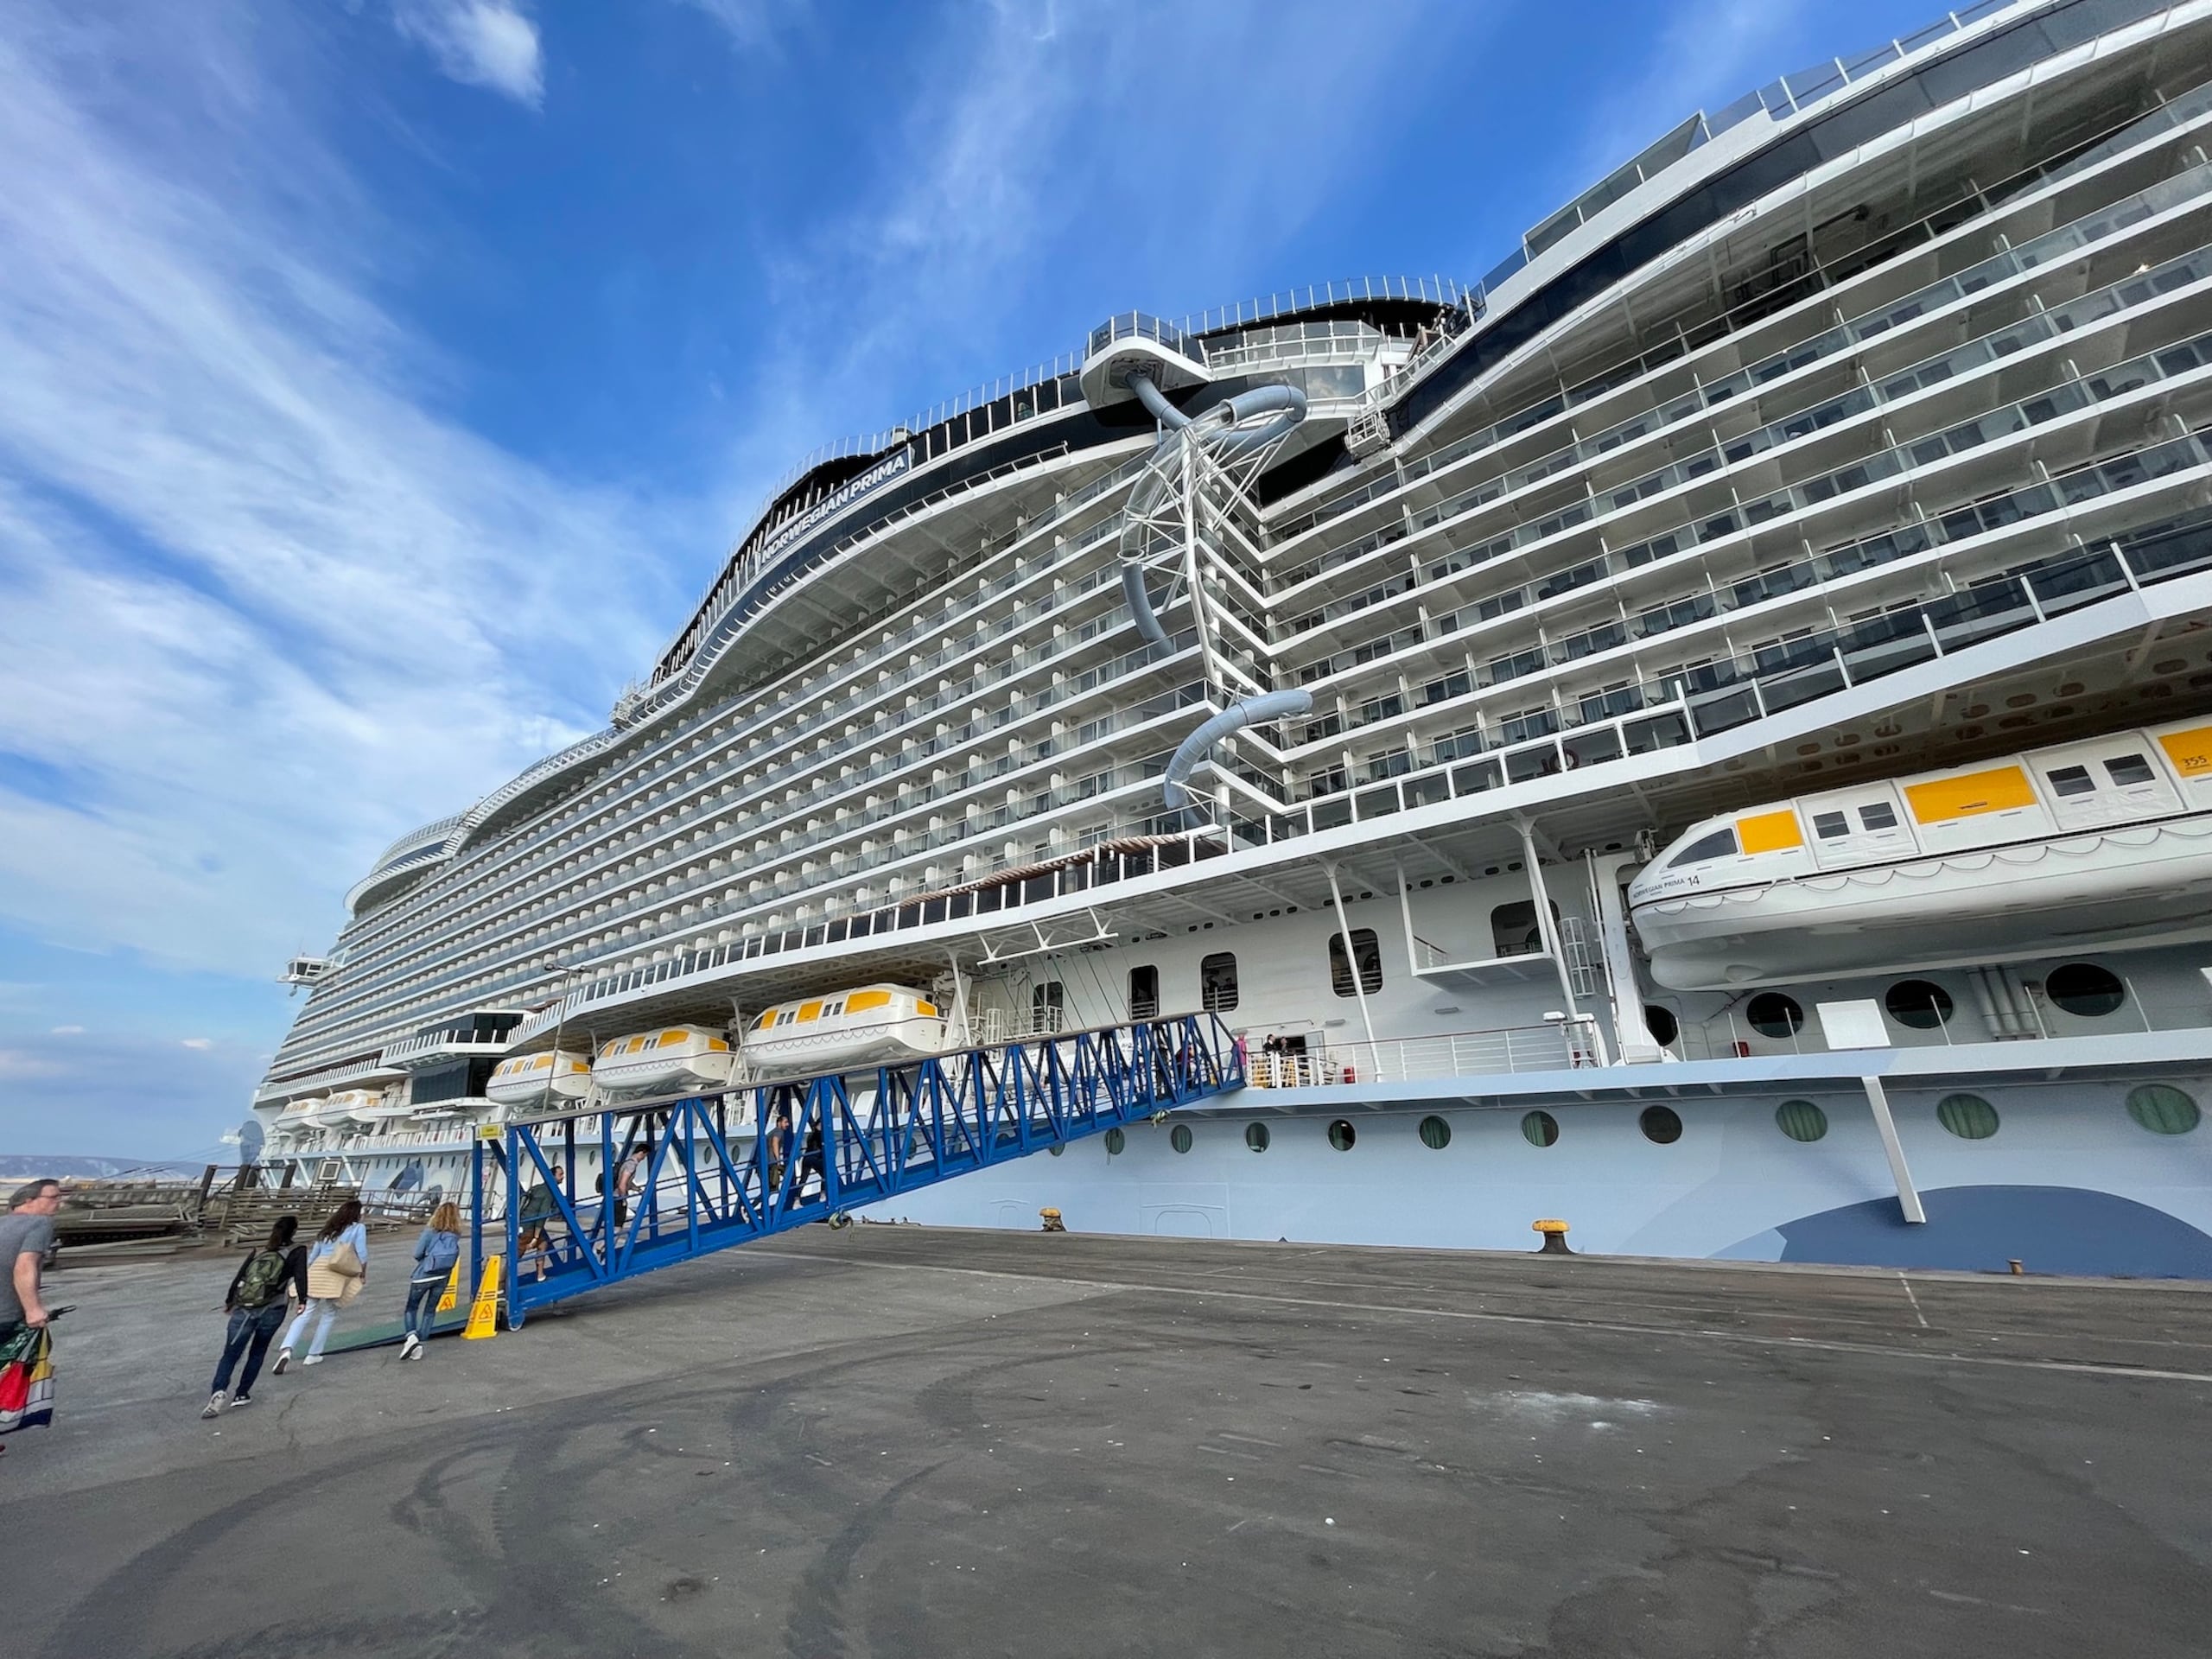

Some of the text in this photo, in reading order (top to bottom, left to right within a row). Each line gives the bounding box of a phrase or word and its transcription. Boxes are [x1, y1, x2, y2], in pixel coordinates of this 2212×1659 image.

[760, 455, 906, 563] NORWEGIAN PRIMA
[1664, 878, 1685, 887] PRIMA
[1688, 874, 1700, 887] 14
